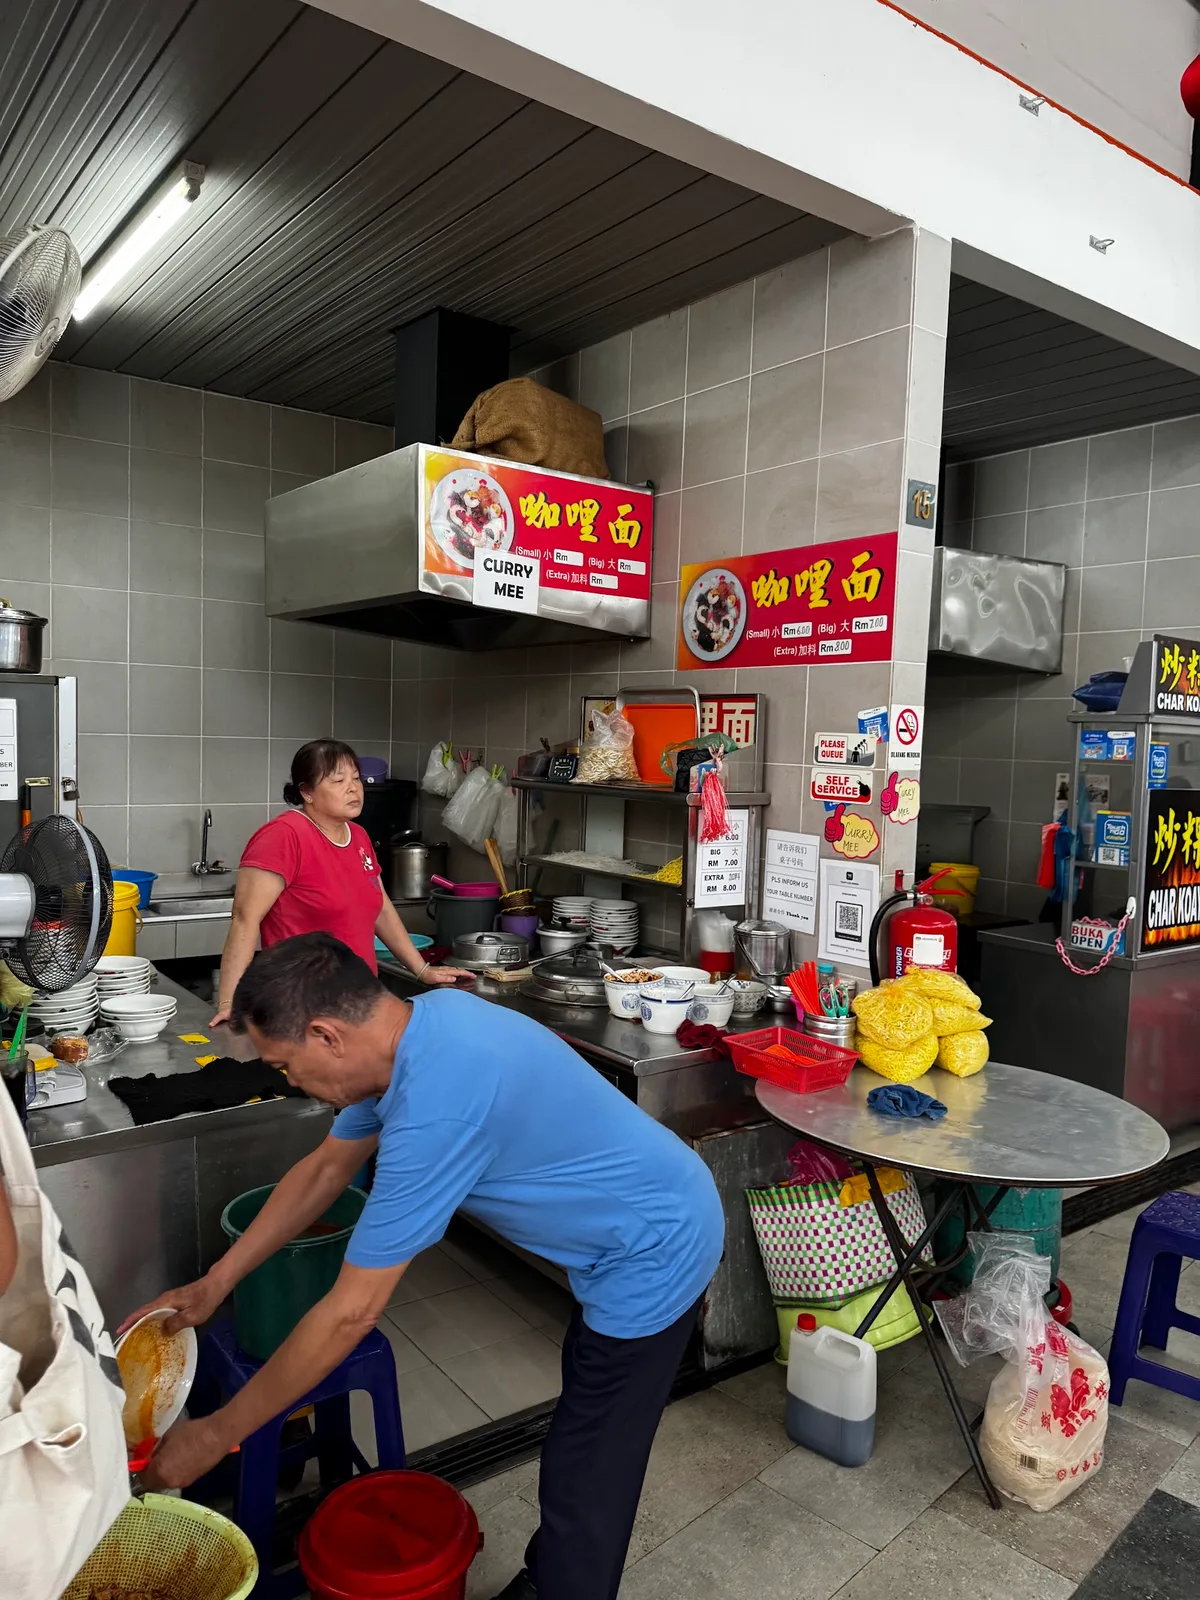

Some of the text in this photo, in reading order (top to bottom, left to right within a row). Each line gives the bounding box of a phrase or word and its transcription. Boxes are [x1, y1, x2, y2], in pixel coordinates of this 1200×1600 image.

[912, 489, 931, 520] 15
[519, 491, 643, 549] 咖哩面
[515, 546, 631, 571] (Small) 小 Rm (Big) 大 Rm
[483, 557, 533, 580] CURRY
[546, 569, 603, 585] (Extra) 加料 Rm
[752, 550, 884, 610] 咖哩面
[494, 583, 524, 600] MEE
[746, 628, 770, 640] (Small)
[771, 626, 780, 638] 小
[817, 623, 837, 635] (Big)
[840, 619, 850, 633] 大
[774, 646, 798, 657] (Extra)
[798, 643, 817, 656] 加料
[1157, 692, 1200, 712] CHAR KO
[820, 739, 846, 749] PLEASE
[821, 750, 843, 759] QUEUE
[825, 775, 850, 786] SELF
[817, 784, 858, 796] SERVICE
[732, 847, 738, 856] 大
[843, 840, 859, 852] MEE
[771, 876, 781, 884] PLS
[782, 878, 800, 887] INFORM
[766, 888, 813, 902] YOUR TABLE NUMBER
[1148, 885, 1200, 929] CHAR KOA
[1071, 925, 1104, 939] BUKA
[1071, 935, 1103, 949] OPEN
[895, 946, 903, 976] POWDER
